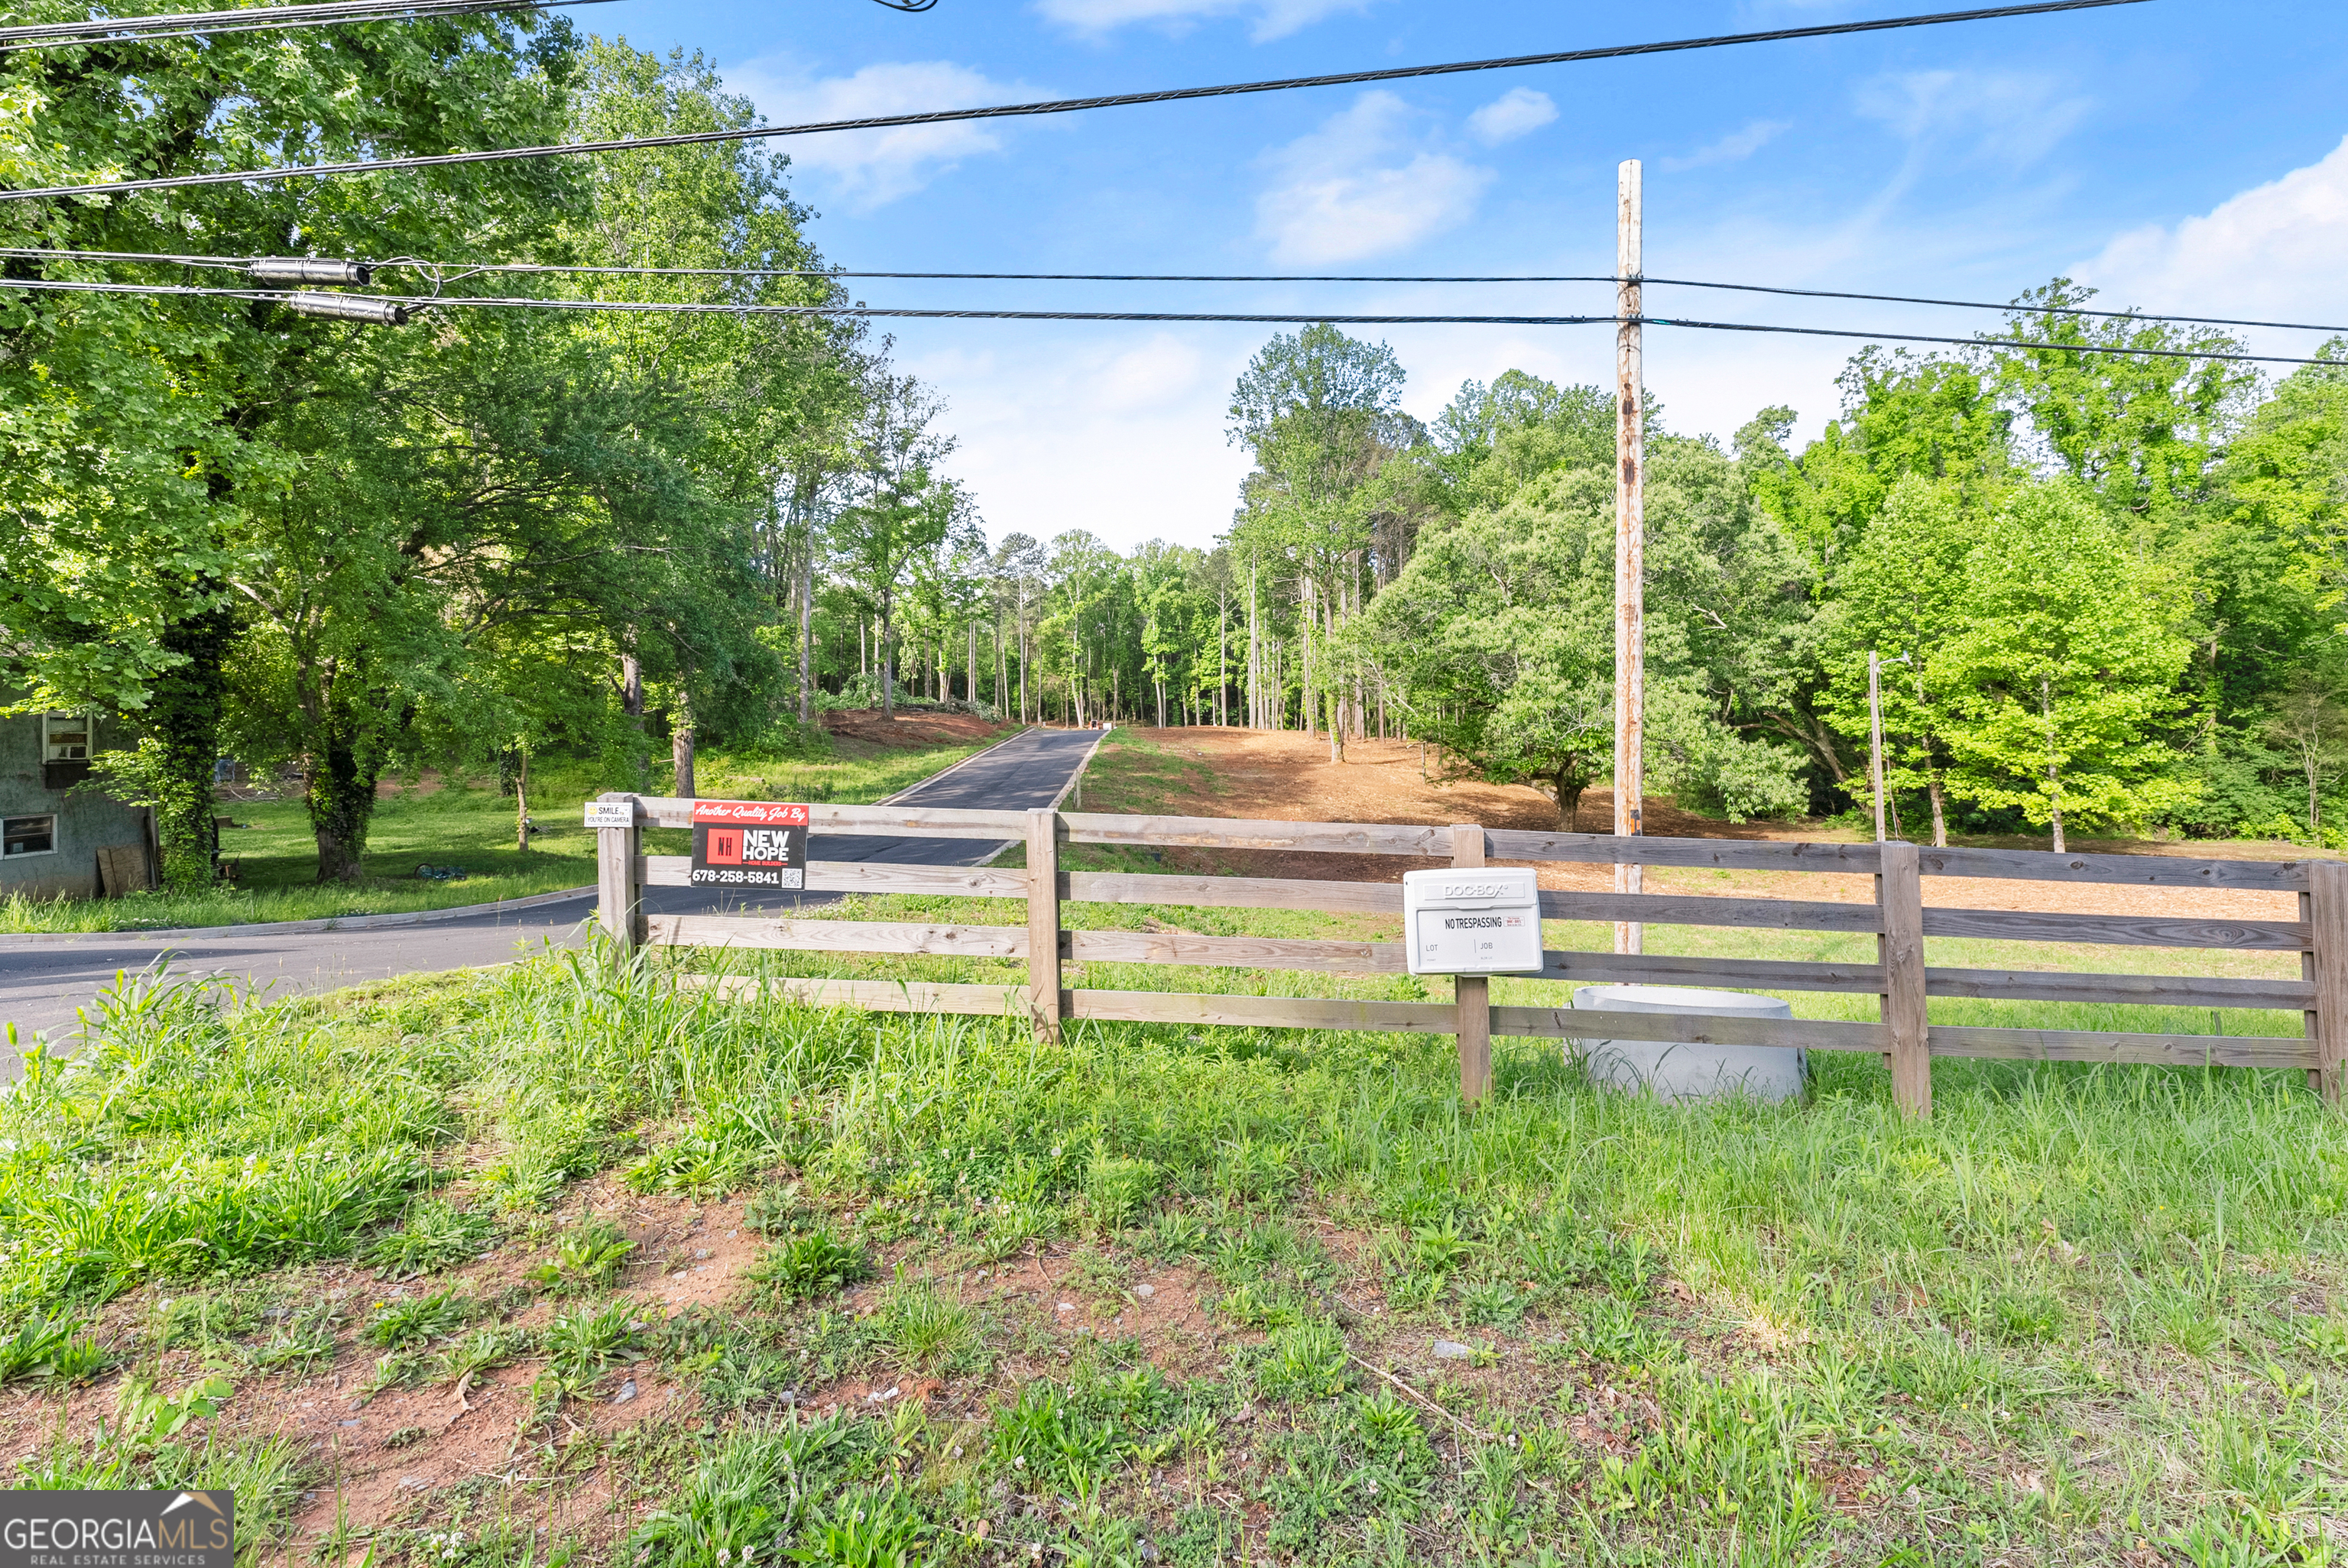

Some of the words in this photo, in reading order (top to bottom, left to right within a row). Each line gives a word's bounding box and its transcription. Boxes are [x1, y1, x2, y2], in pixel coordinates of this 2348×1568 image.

[696, 804, 731, 816] Another
[732, 805, 767, 821] Quality
[767, 807, 789, 821] Job
[790, 808, 806, 822] By
[718, 837, 732, 856] NH
[743, 829, 790, 848] NEW
[742, 846, 789, 861] HOPE
[692, 869, 780, 884] 678-258-5841
[1445, 918, 1455, 929] NO
[1455, 916, 1502, 928] TRESPASSING
